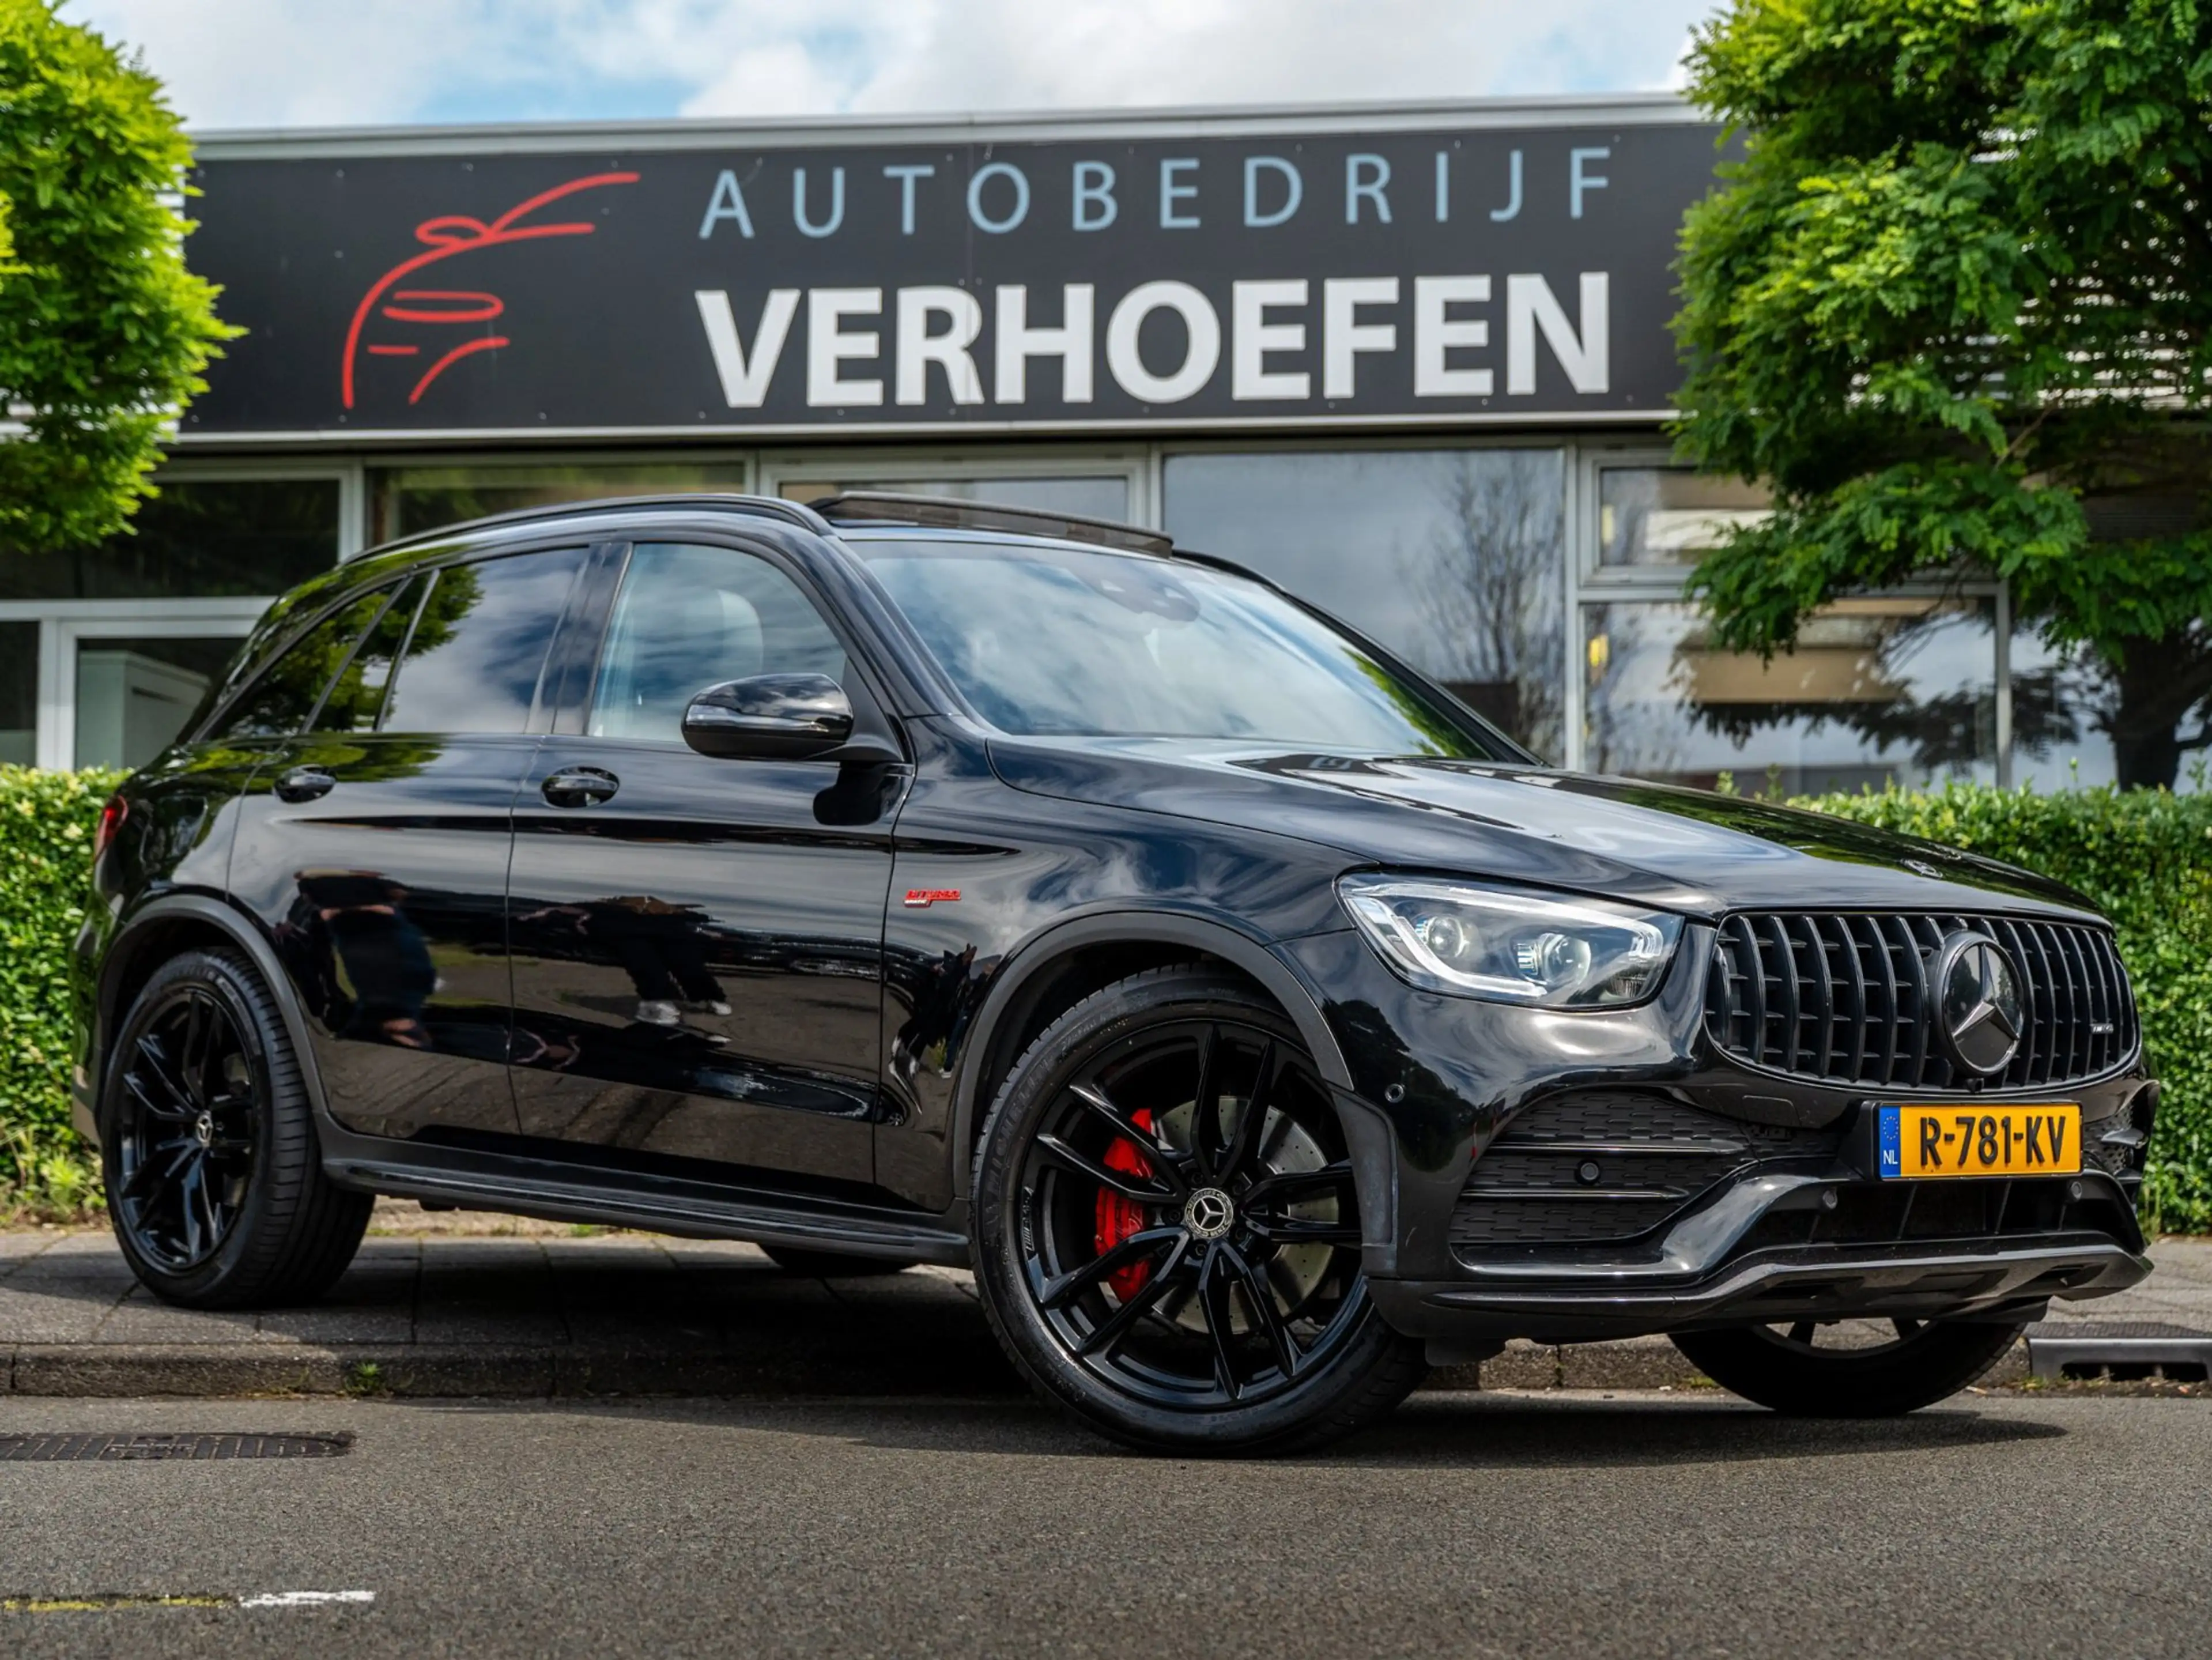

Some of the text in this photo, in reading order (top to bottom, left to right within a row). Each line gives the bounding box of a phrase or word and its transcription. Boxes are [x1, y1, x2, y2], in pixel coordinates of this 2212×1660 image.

[699, 147, 1610, 238] AUTOBEDRIJF
[694, 272, 1609, 408] VERHOEFEN
[1883, 1149, 1898, 1165] NL
[1920, 1115, 2066, 1167] R-781-KV
